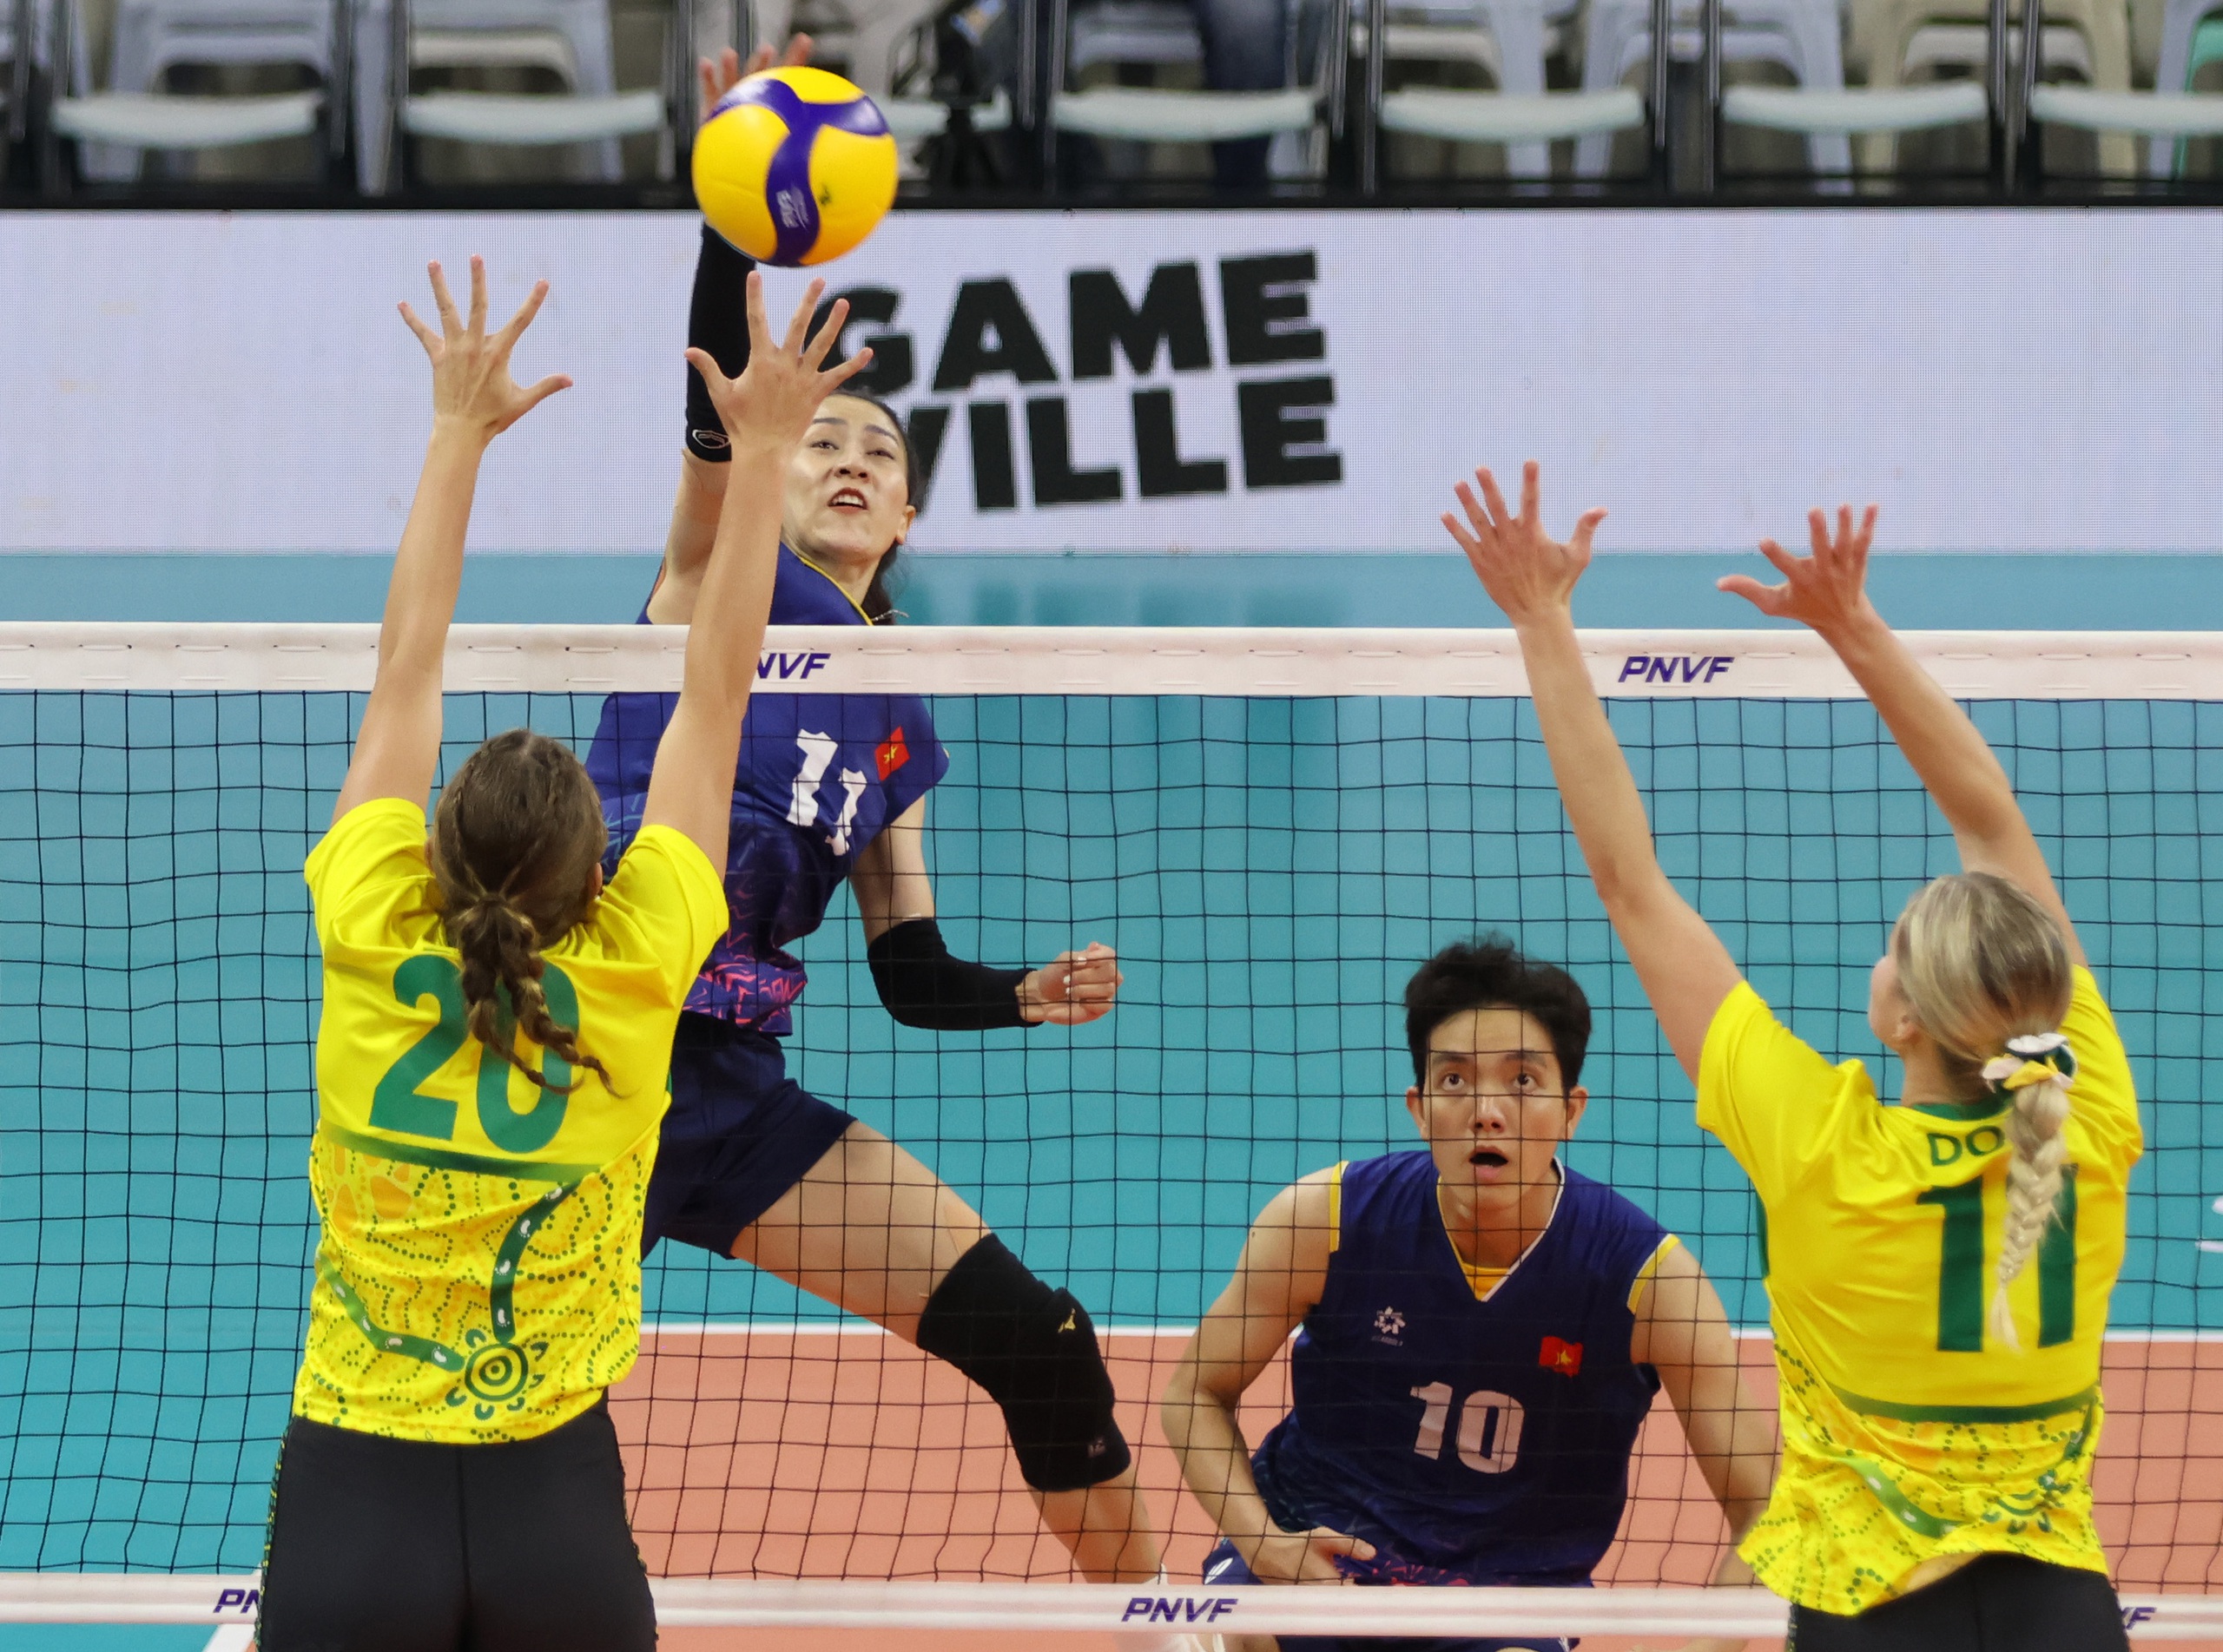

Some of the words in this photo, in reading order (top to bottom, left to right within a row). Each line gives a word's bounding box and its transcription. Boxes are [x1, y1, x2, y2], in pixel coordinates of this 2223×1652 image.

[802, 251, 1325, 397] GAME
[757, 653, 831, 679] NVF
[1618, 656, 1735, 682] PNVF
[368, 954, 580, 1154] 20
[1916, 1163, 2078, 1352] 11
[1409, 1381, 1525, 1474] 10
[213, 1589, 260, 1614] PN
[1121, 1597, 1238, 1622] PNVF
